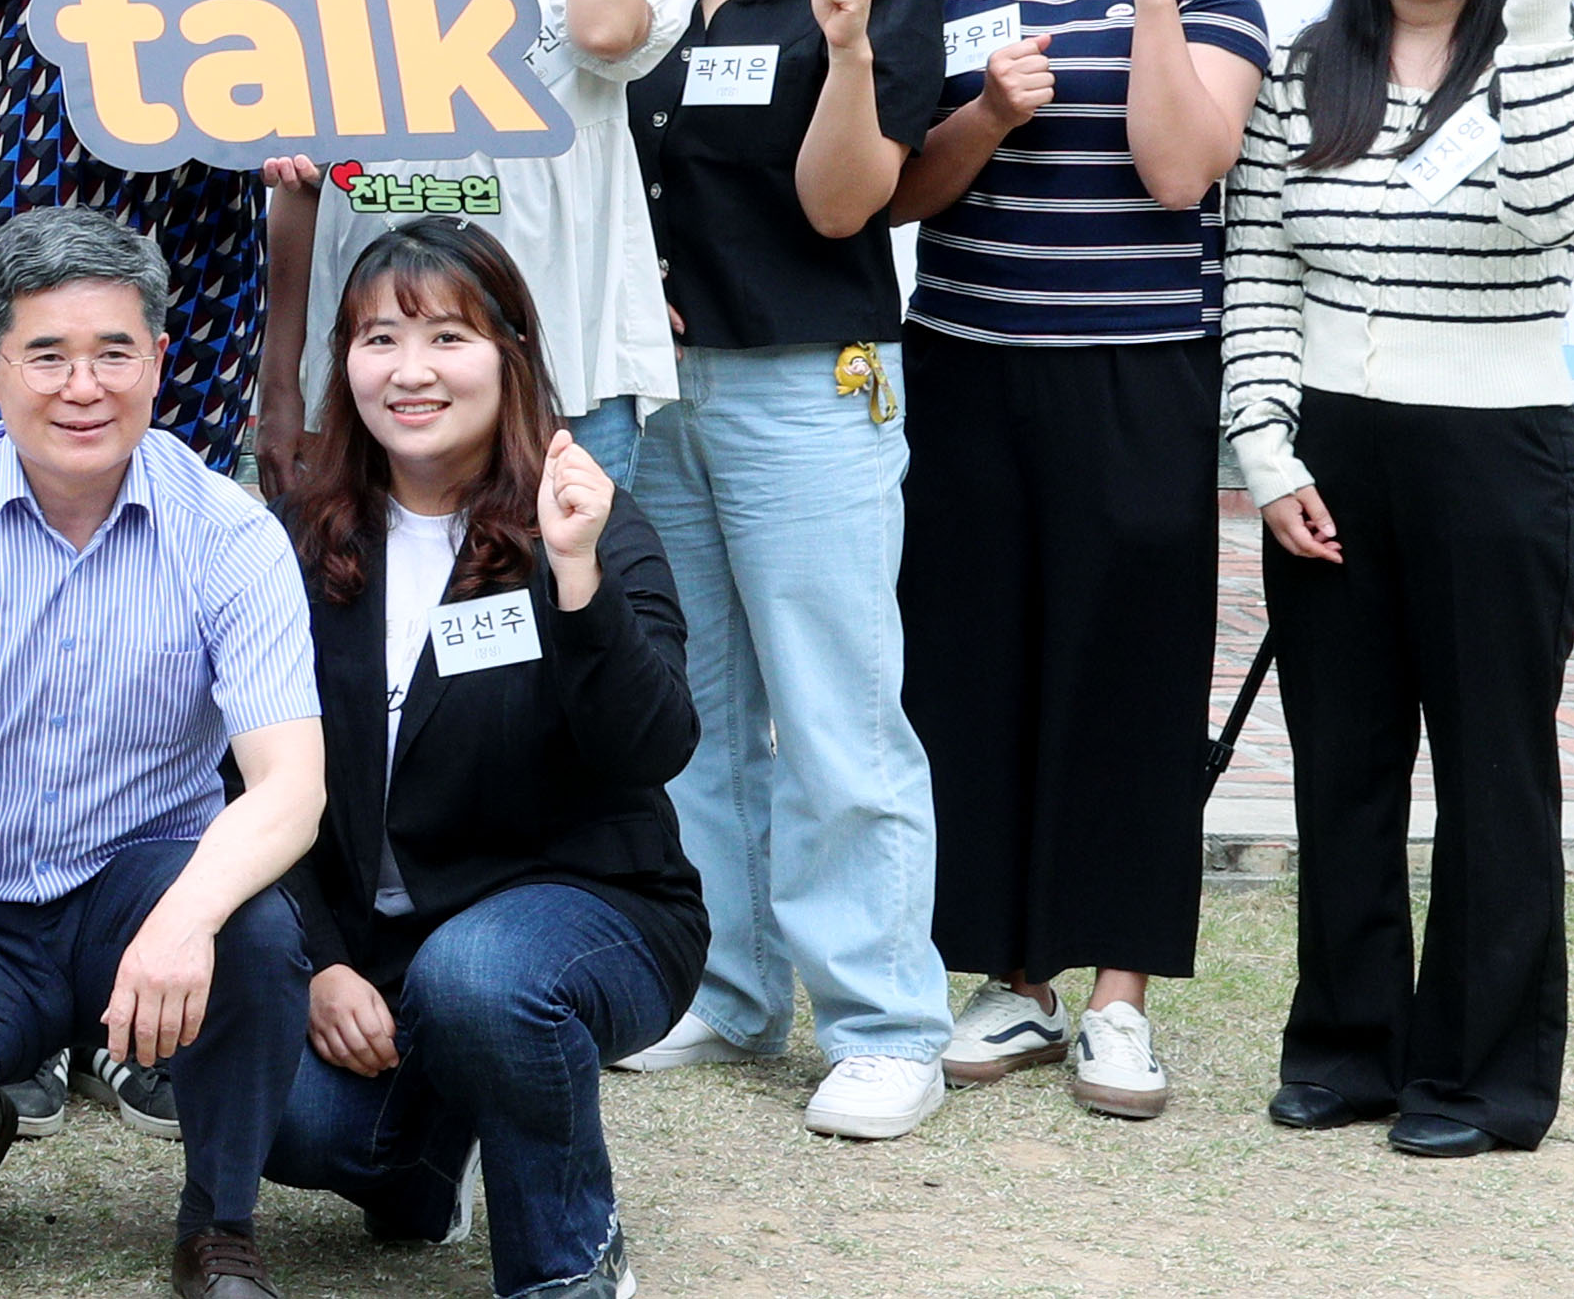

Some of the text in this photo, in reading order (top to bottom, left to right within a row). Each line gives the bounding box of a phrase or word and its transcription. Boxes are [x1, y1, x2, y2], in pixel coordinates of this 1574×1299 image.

[695, 57, 769, 82] 곽지은
[1411, 116, 1485, 182] 김지영
[348, 174, 501, 214] 전남농업
[440, 605, 526, 647] 김선주
